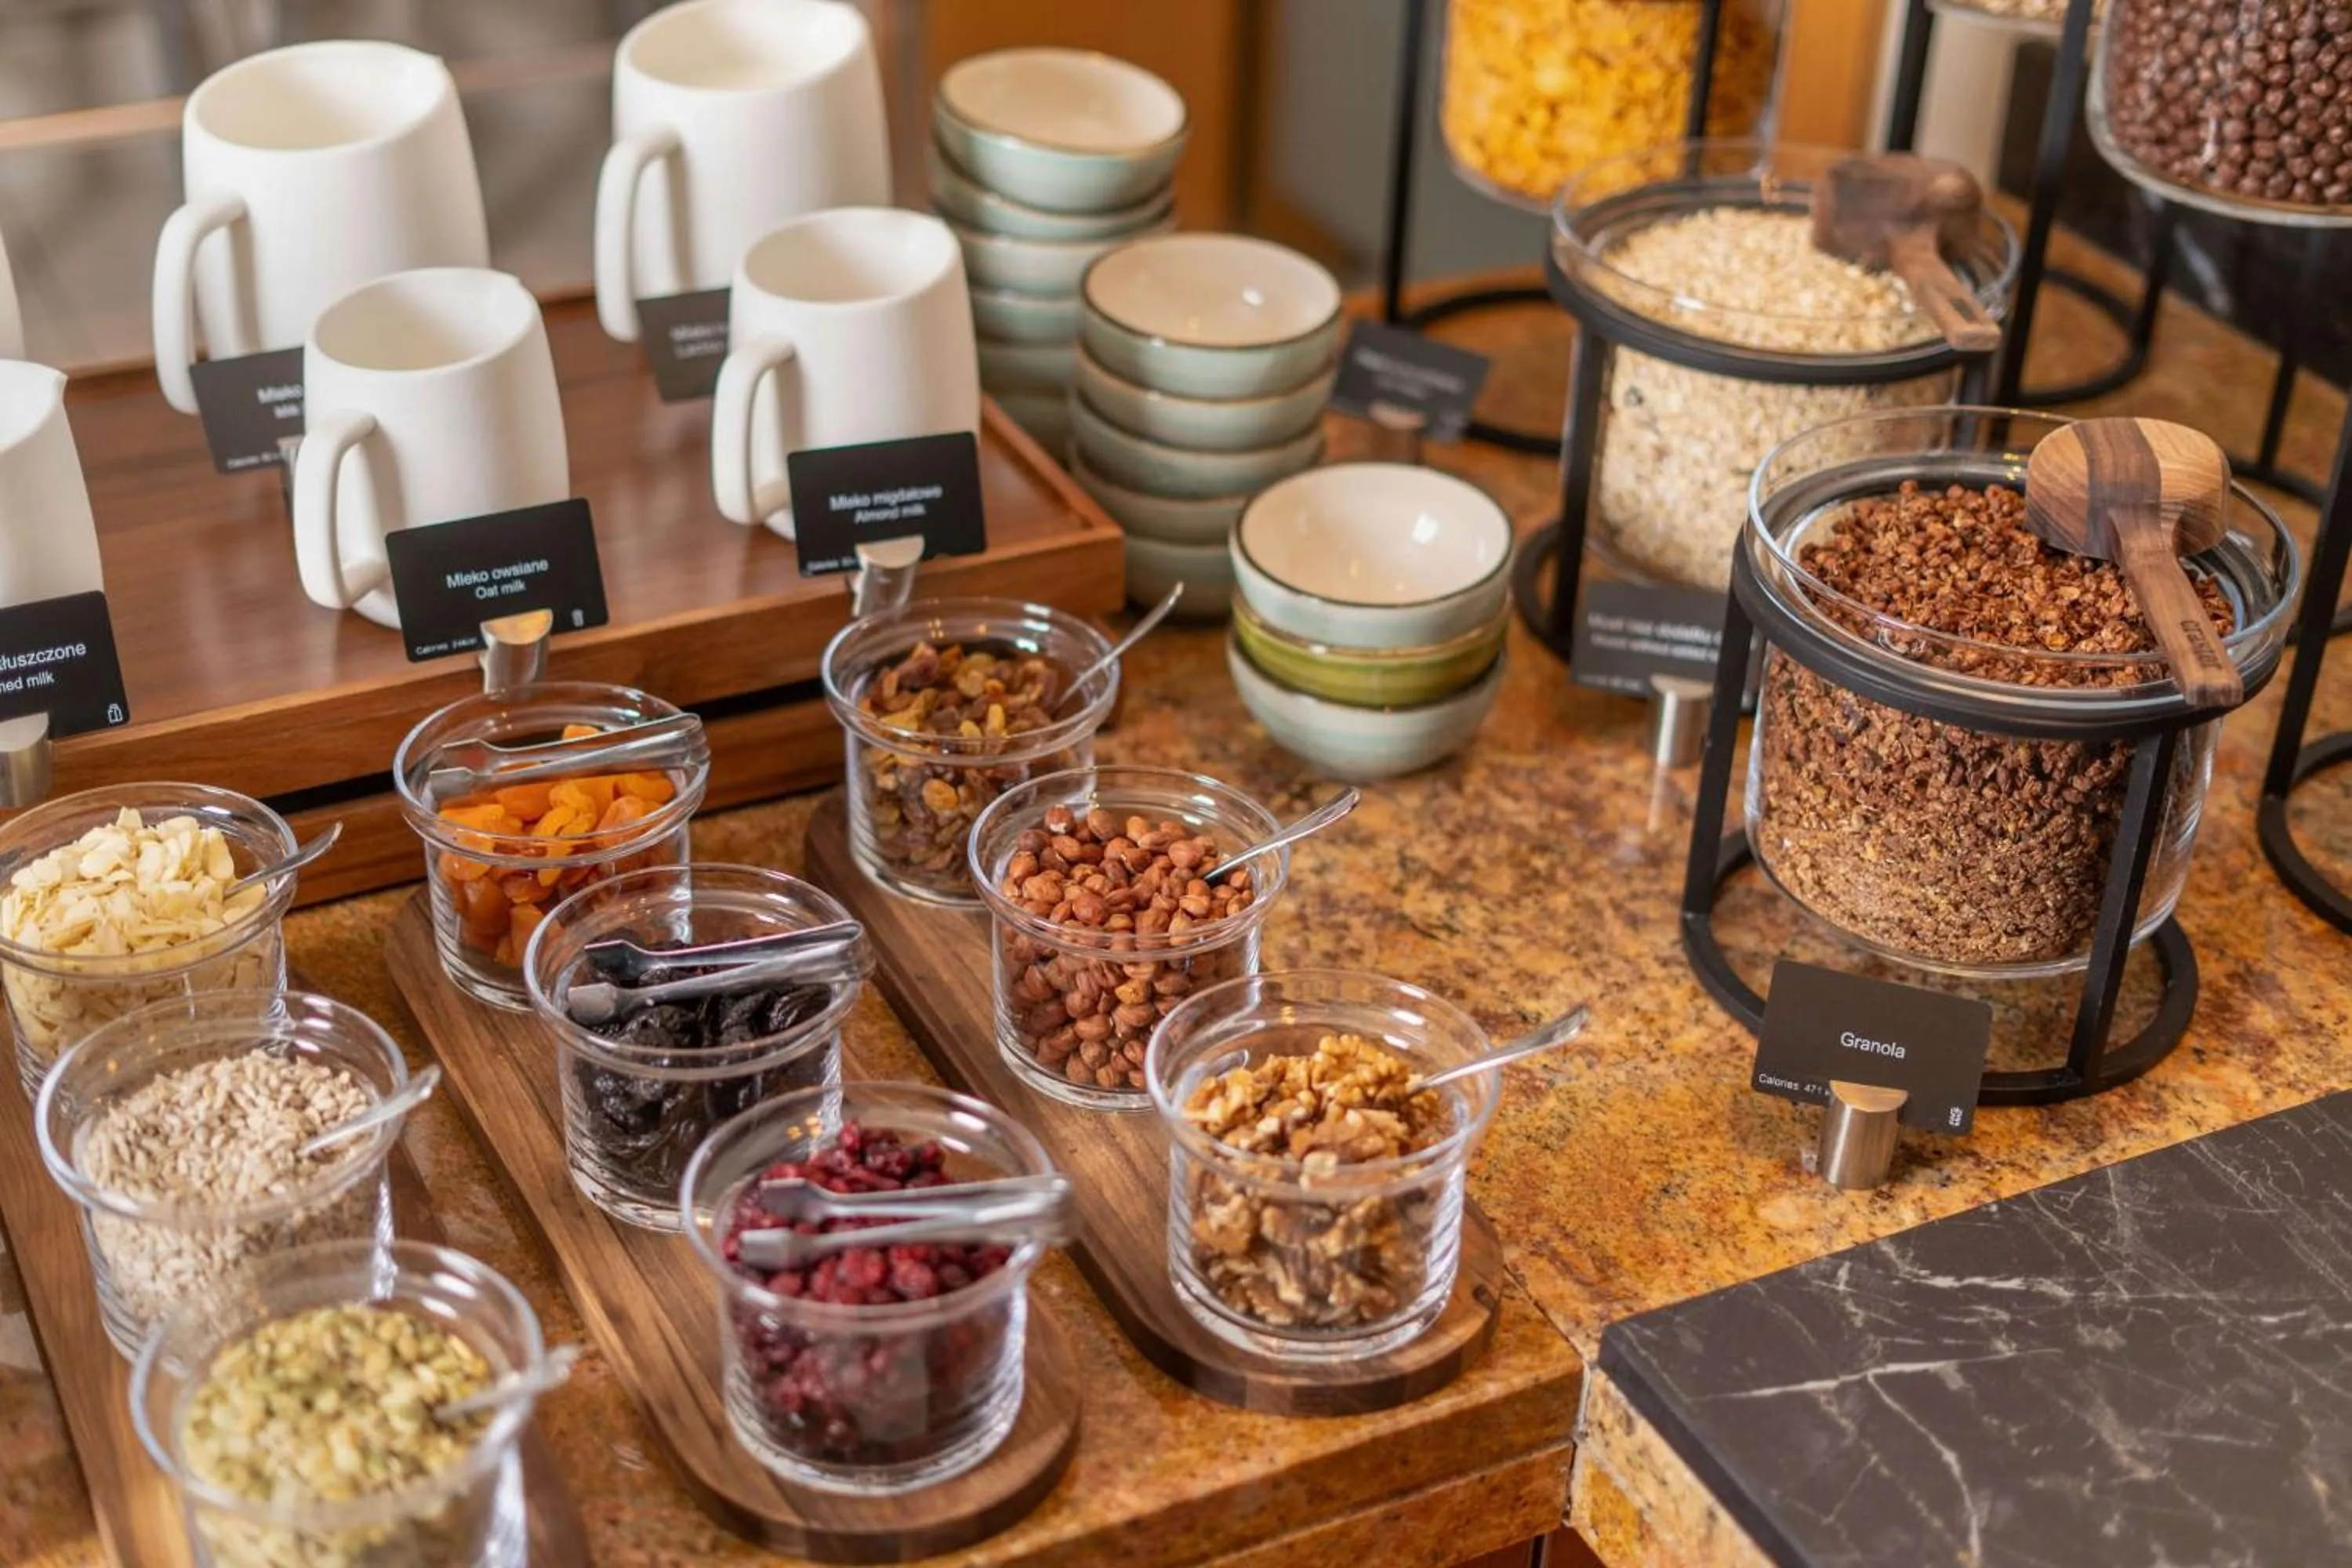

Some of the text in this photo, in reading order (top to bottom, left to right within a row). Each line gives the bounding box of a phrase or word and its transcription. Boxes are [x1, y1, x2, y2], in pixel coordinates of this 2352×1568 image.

[829, 493, 871, 510] Mleko
[446, 559, 549, 589] Mleko owsiane
[475, 579, 526, 599] Oat milk
[27, 670, 54, 688] milk
[1840, 1031, 1906, 1059] Granola
[1759, 1073, 1800, 1091] Calories
